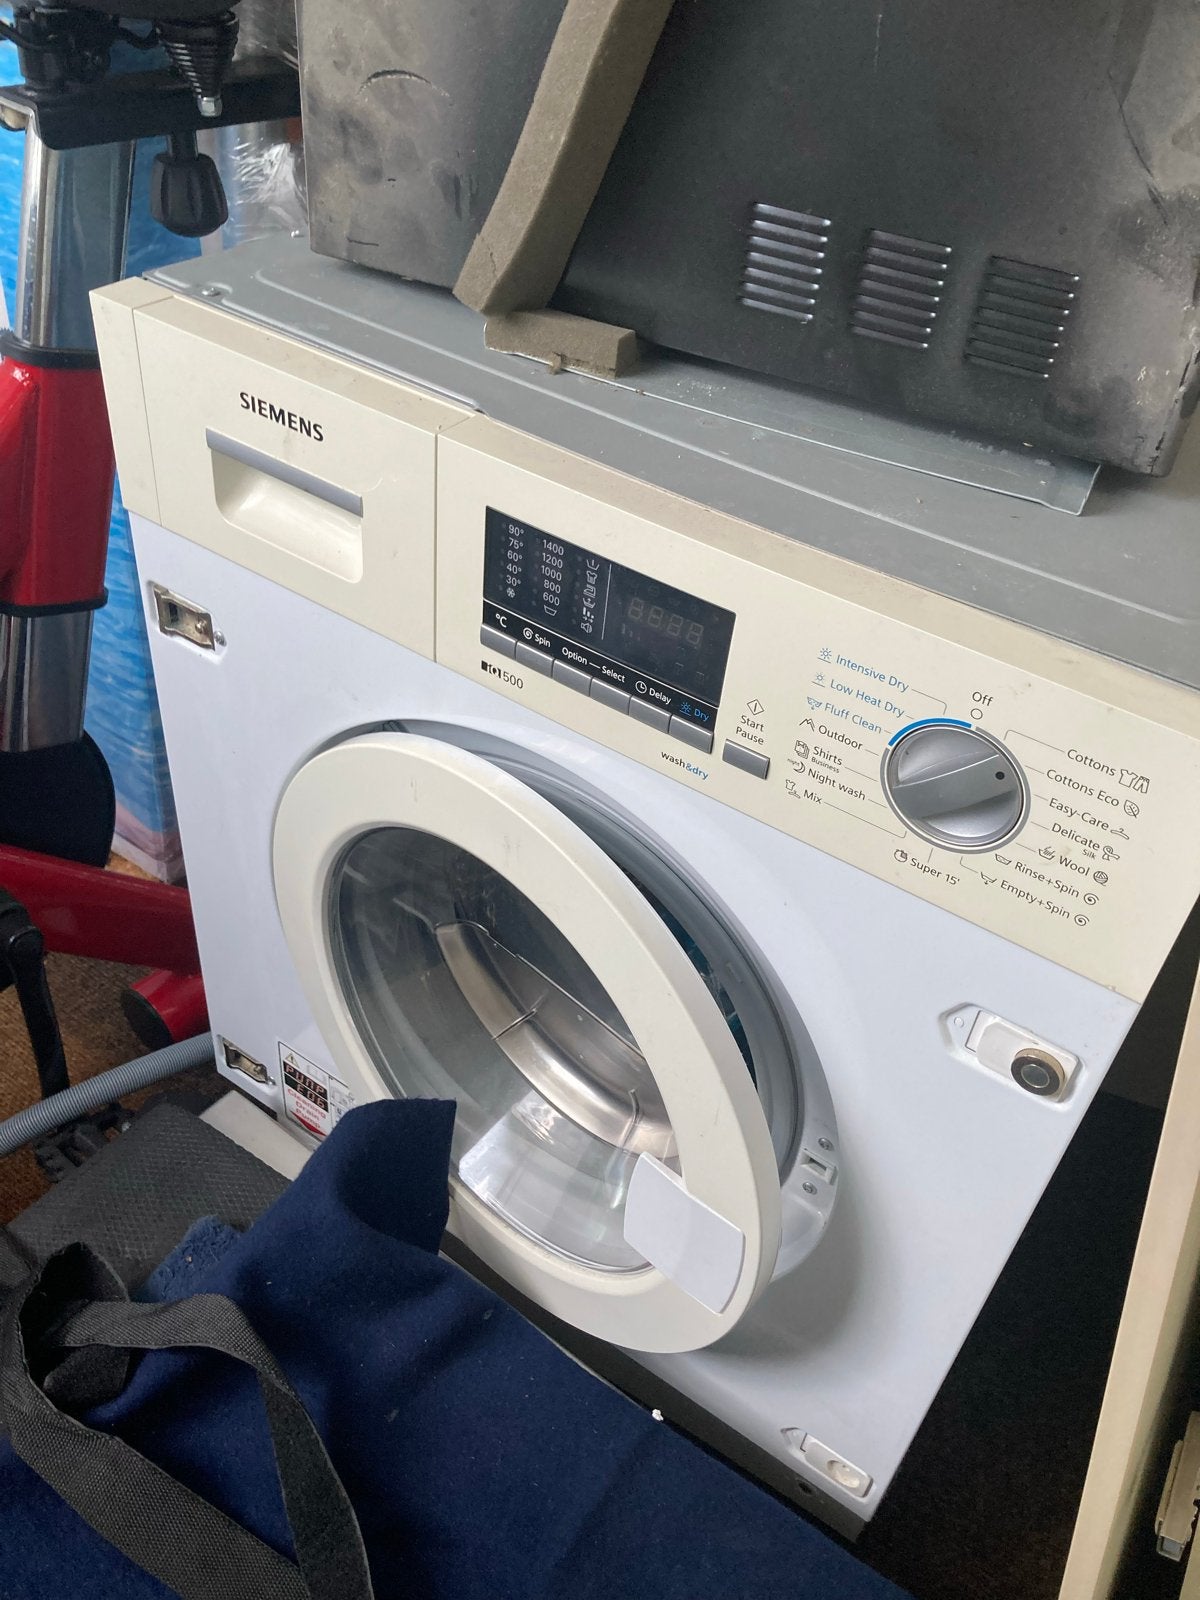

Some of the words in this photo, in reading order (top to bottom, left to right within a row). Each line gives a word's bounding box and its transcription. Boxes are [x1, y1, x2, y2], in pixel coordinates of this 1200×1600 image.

[240, 392, 324, 442] SIEMENS
[543, 539, 564, 556] 1400
[542, 552, 563, 569] 1200
[541, 565, 562, 582] 1000
[543, 579, 561, 594] 800
[542, 592, 560, 606] 600
[534, 633, 551, 648] Spin
[562, 646, 588, 666] Option
[601, 664, 626, 683] Select
[836, 654, 886, 682] Intensive
[888, 675, 910, 693] Dry
[649, 687, 672, 705] Delay
[830, 679, 853, 696] Low
[855, 689, 881, 708] Heat
[884, 702, 906, 719] Dry
[972, 691, 993, 707] Off
[694, 708, 710, 721] Dry
[740, 714, 765, 732] Start
[824, 702, 850, 720] Fluff
[852, 713, 883, 734] Clean
[736, 726, 765, 745] Pause
[818, 724, 864, 751] Outdoor
[661, 750, 709, 780] wash&dry
[811, 756, 840, 774] Business
[813, 746, 843, 766] Shirts
[1067, 749, 1116, 777] Cottons
[808, 768, 836, 787] Night
[838, 783, 866, 801] wash
[1046, 769, 1095, 797] Cottons
[1097, 790, 1120, 808] Eco
[803, 789, 822, 804] Mix
[1049, 797, 1110, 831] Easy-Care
[1051, 822, 1101, 851] Delicate
[1083, 848, 1096, 860] Silk
[910, 857, 942, 880] Super
[1059, 855, 1091, 876] Wool
[1015, 861, 1080, 898] Rinse+Spin
[1000, 879, 1071, 919] Empty+Spin
